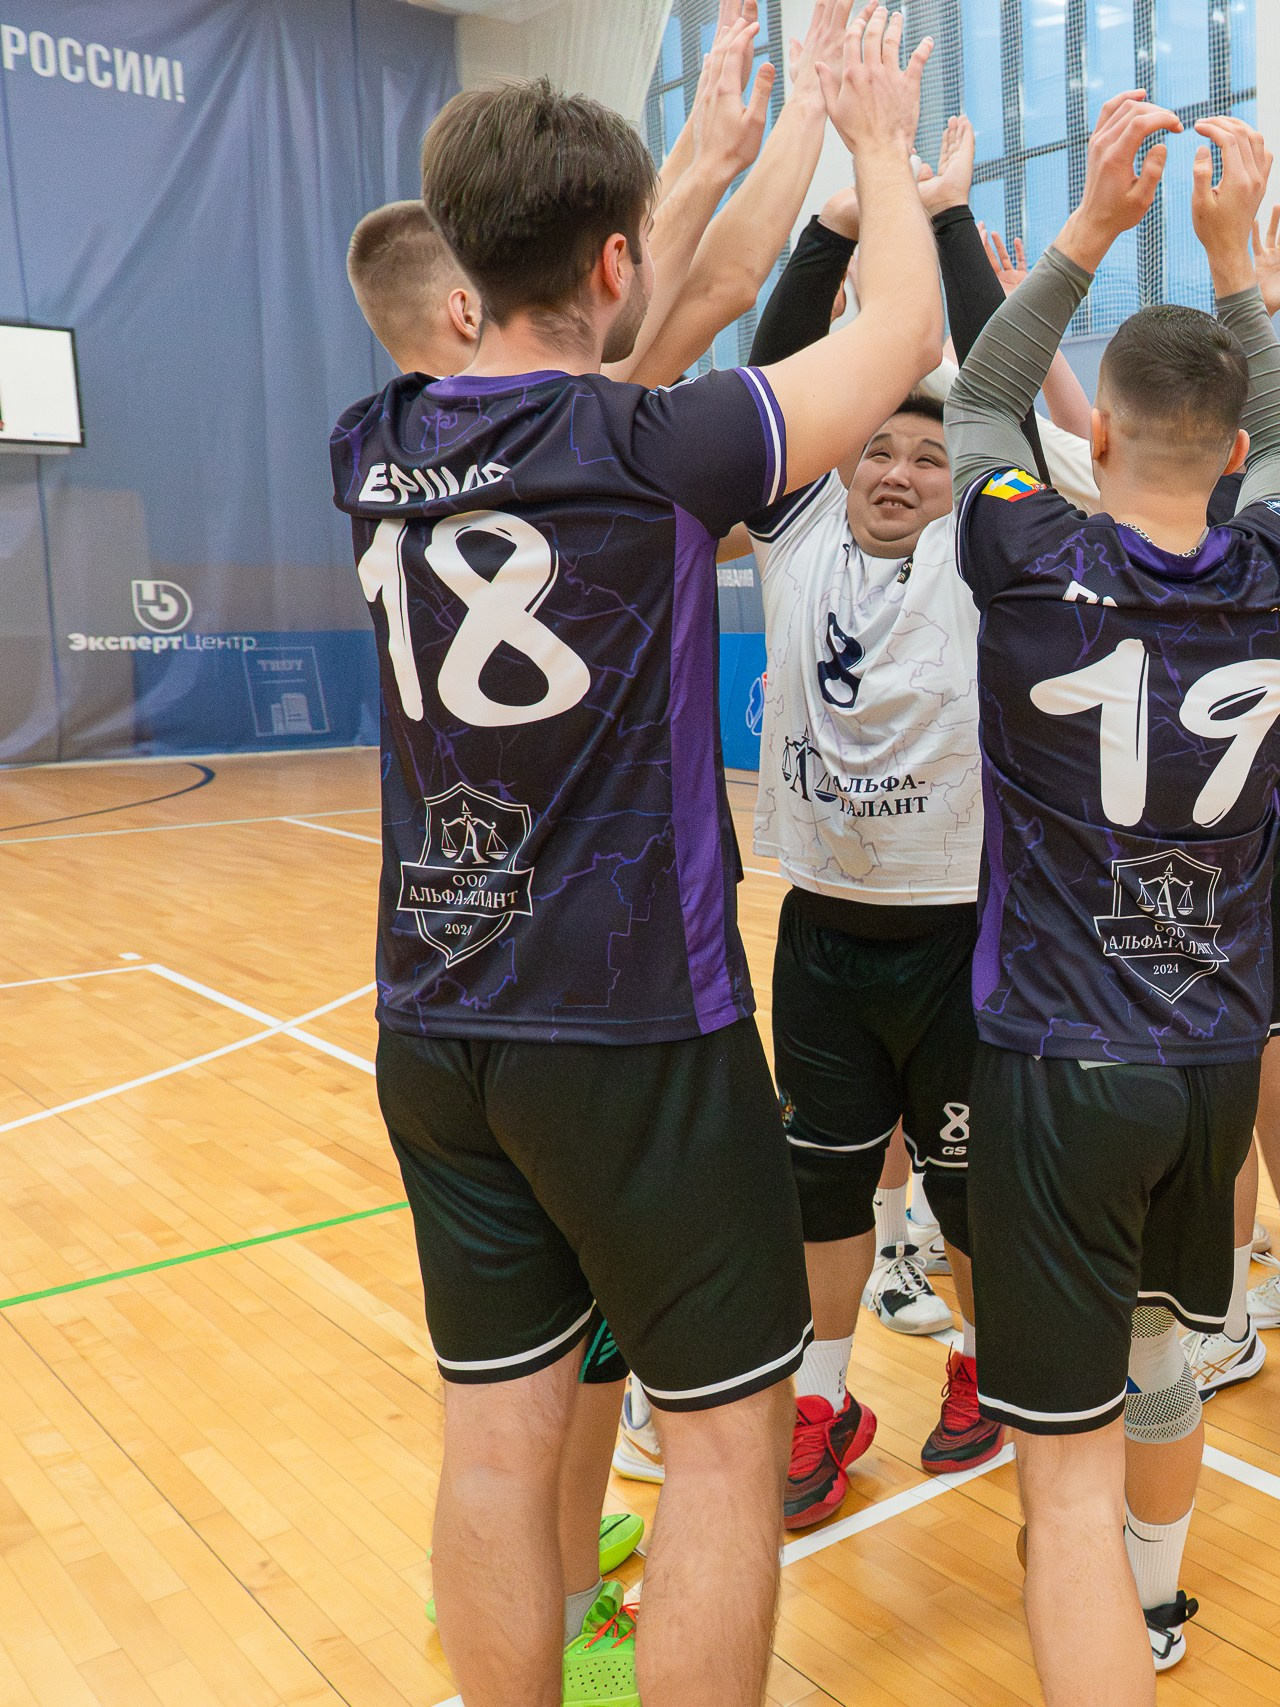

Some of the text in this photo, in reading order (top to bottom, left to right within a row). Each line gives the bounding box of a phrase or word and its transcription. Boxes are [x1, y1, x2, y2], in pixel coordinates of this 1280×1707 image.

[1, 23, 186, 103] РОССИИ!
[358, 510, 591, 727] 18
[67, 632, 258, 654] ЭкспертЦентр
[833, 774, 926, 794] АЛЬФА-
[452, 874, 488, 888] ООО
[1153, 963, 1179, 975] 2024
[939, 1102, 970, 1142] 8
[941, 1146, 967, 1156] GS
